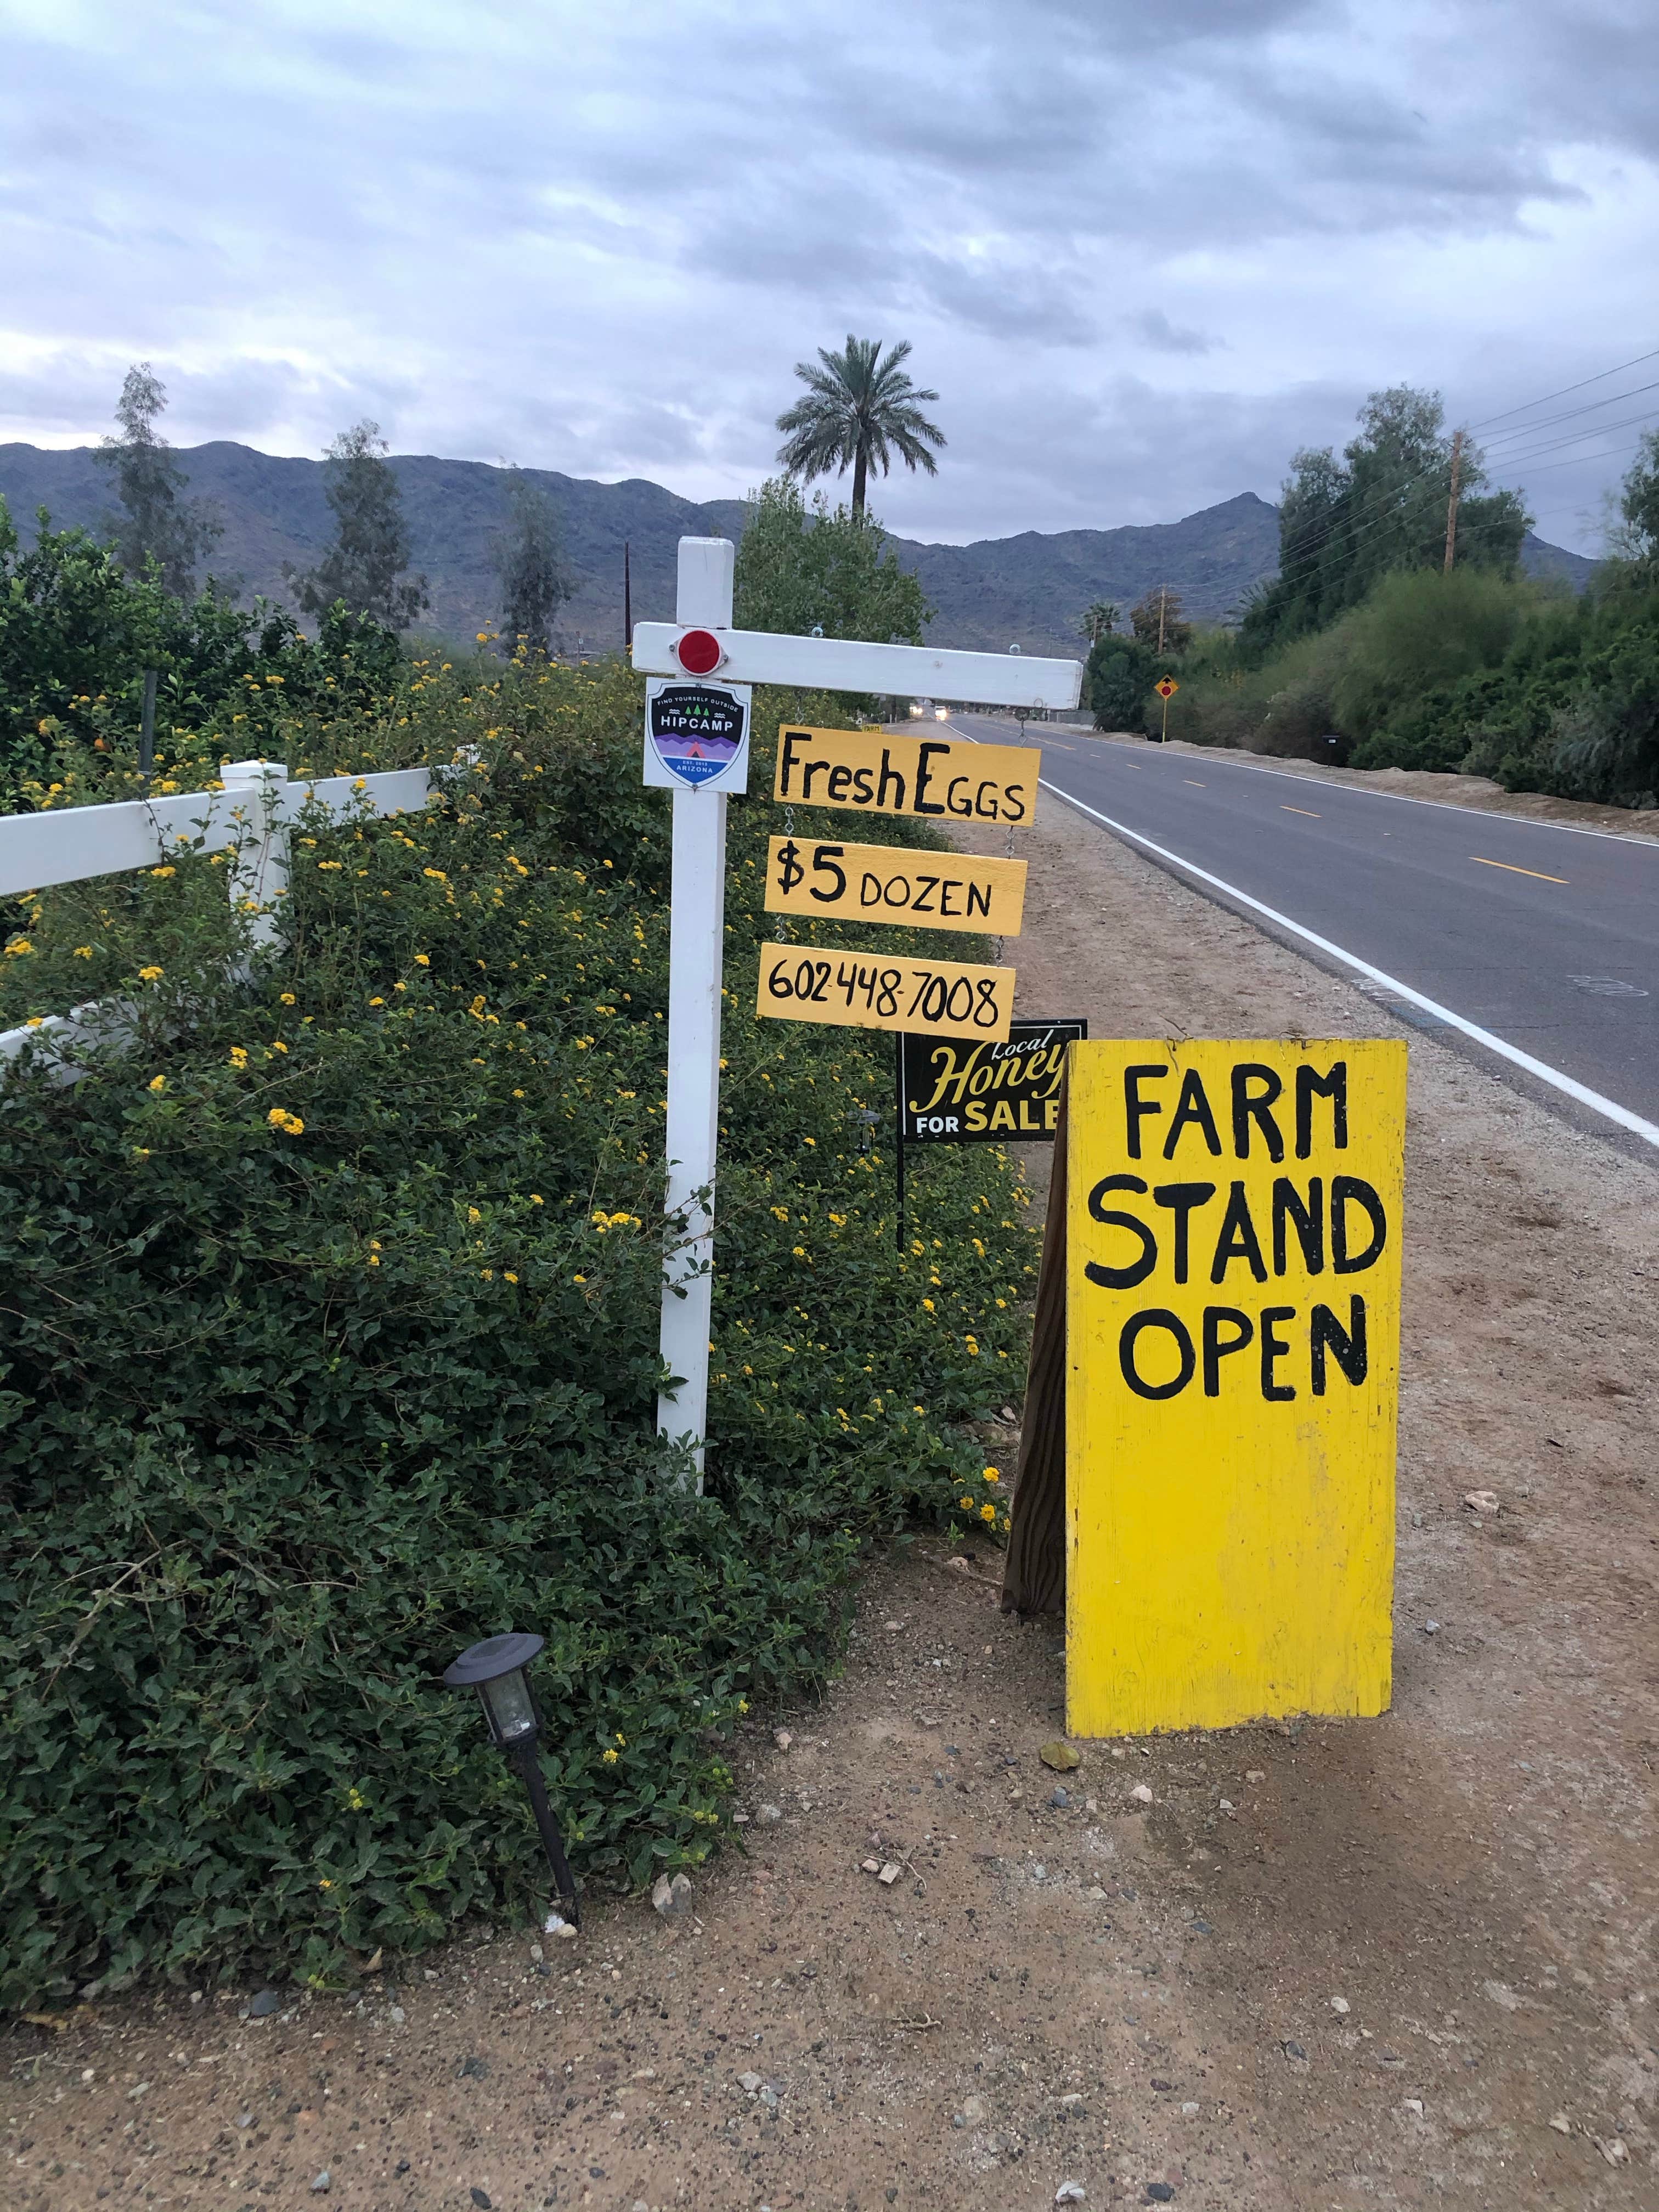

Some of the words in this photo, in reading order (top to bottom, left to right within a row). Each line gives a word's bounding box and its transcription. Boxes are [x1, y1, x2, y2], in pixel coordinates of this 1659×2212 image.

[661, 715, 733, 731] HIPCAMP
[710, 698, 738, 712] OUTSIDE
[780, 732, 905, 810] Fresh
[777, 840, 847, 903] $5
[860, 872, 992, 917] DOZEN
[909, 1042, 1066, 1113] Honey
[991, 1029, 1054, 1060] Local
[917, 1116, 959, 1133] FOR
[965, 1100, 1058, 1131] SALE
[1124, 1062, 1348, 1164] FARM
[1084, 1173, 1386, 1290] STAND
[1119, 1294, 1368, 1402] OPEN
